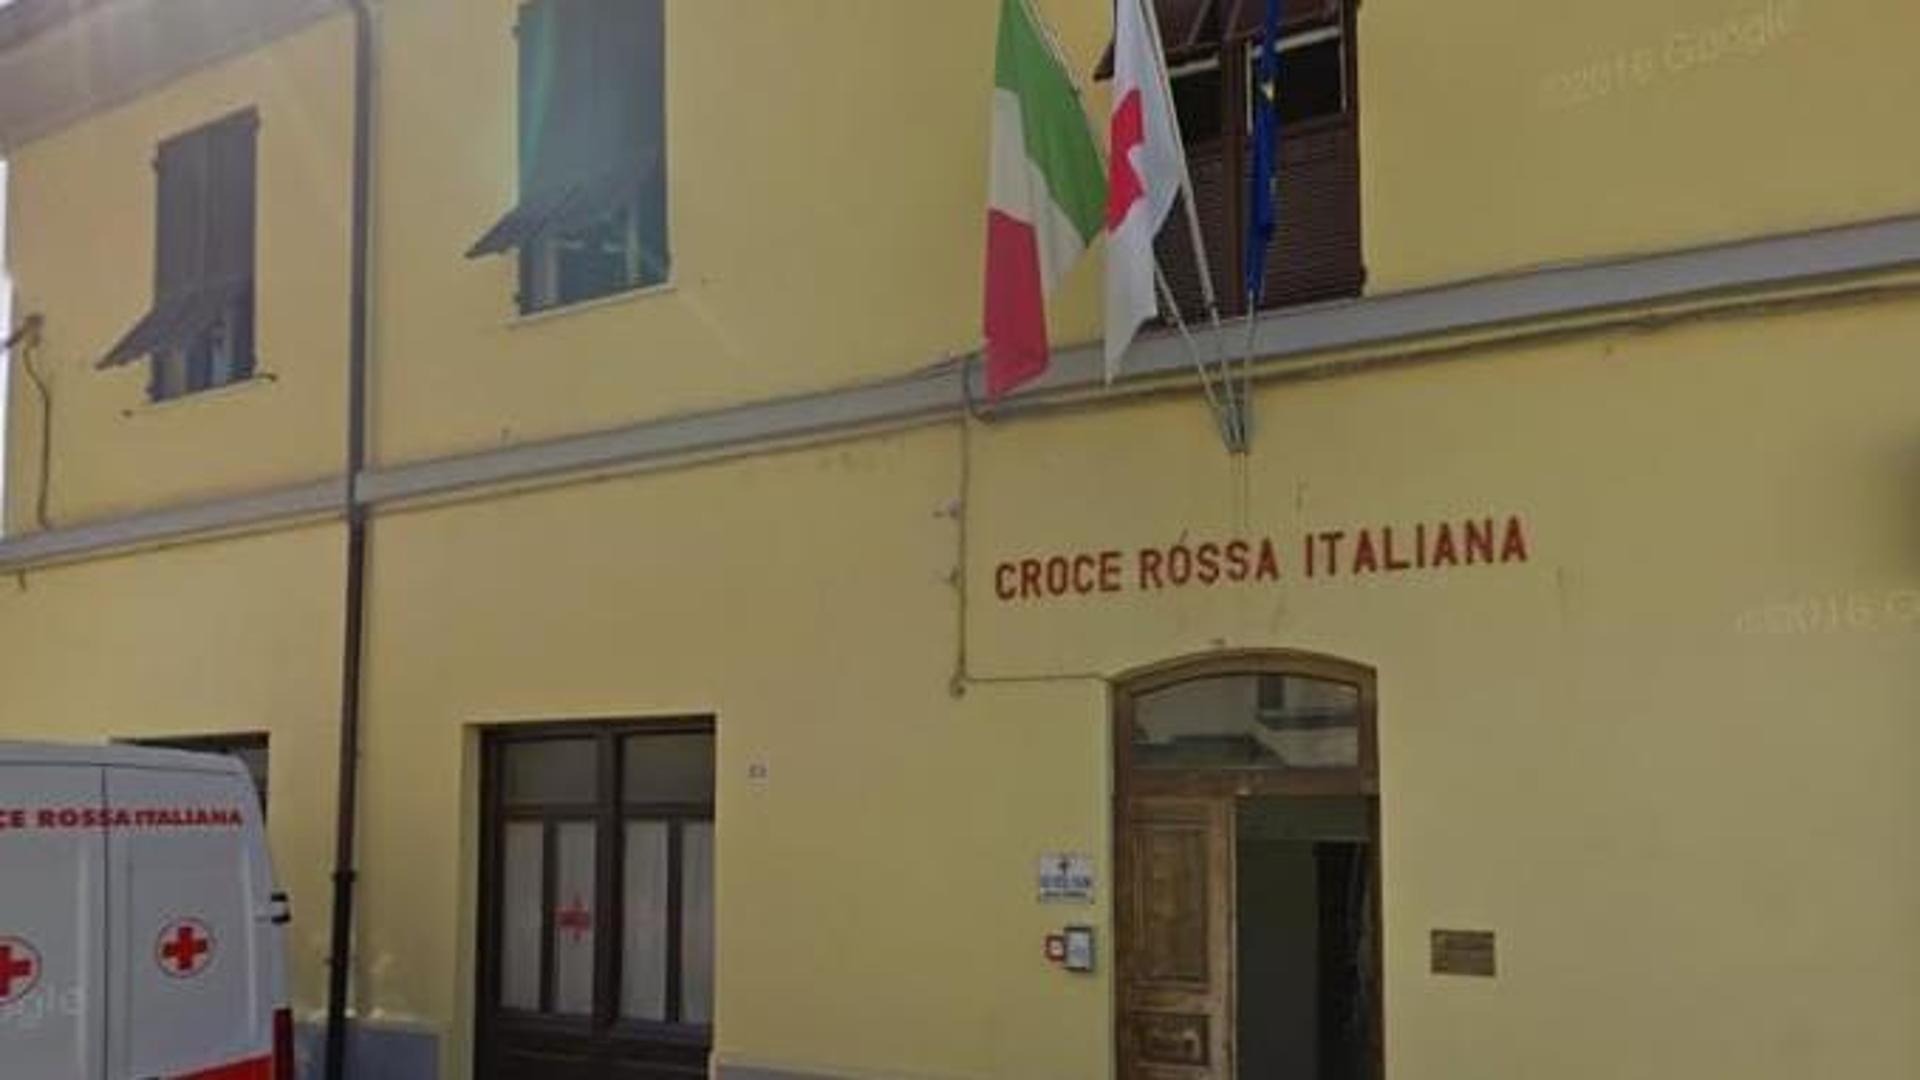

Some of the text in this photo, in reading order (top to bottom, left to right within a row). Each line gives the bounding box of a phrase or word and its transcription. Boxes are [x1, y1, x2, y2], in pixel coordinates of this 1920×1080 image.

[994, 515, 1528, 600] CROCE ROSSA ITALIANA
[37, 808, 130, 828] ROSSA
[134, 808, 243, 827] ITALIANA
